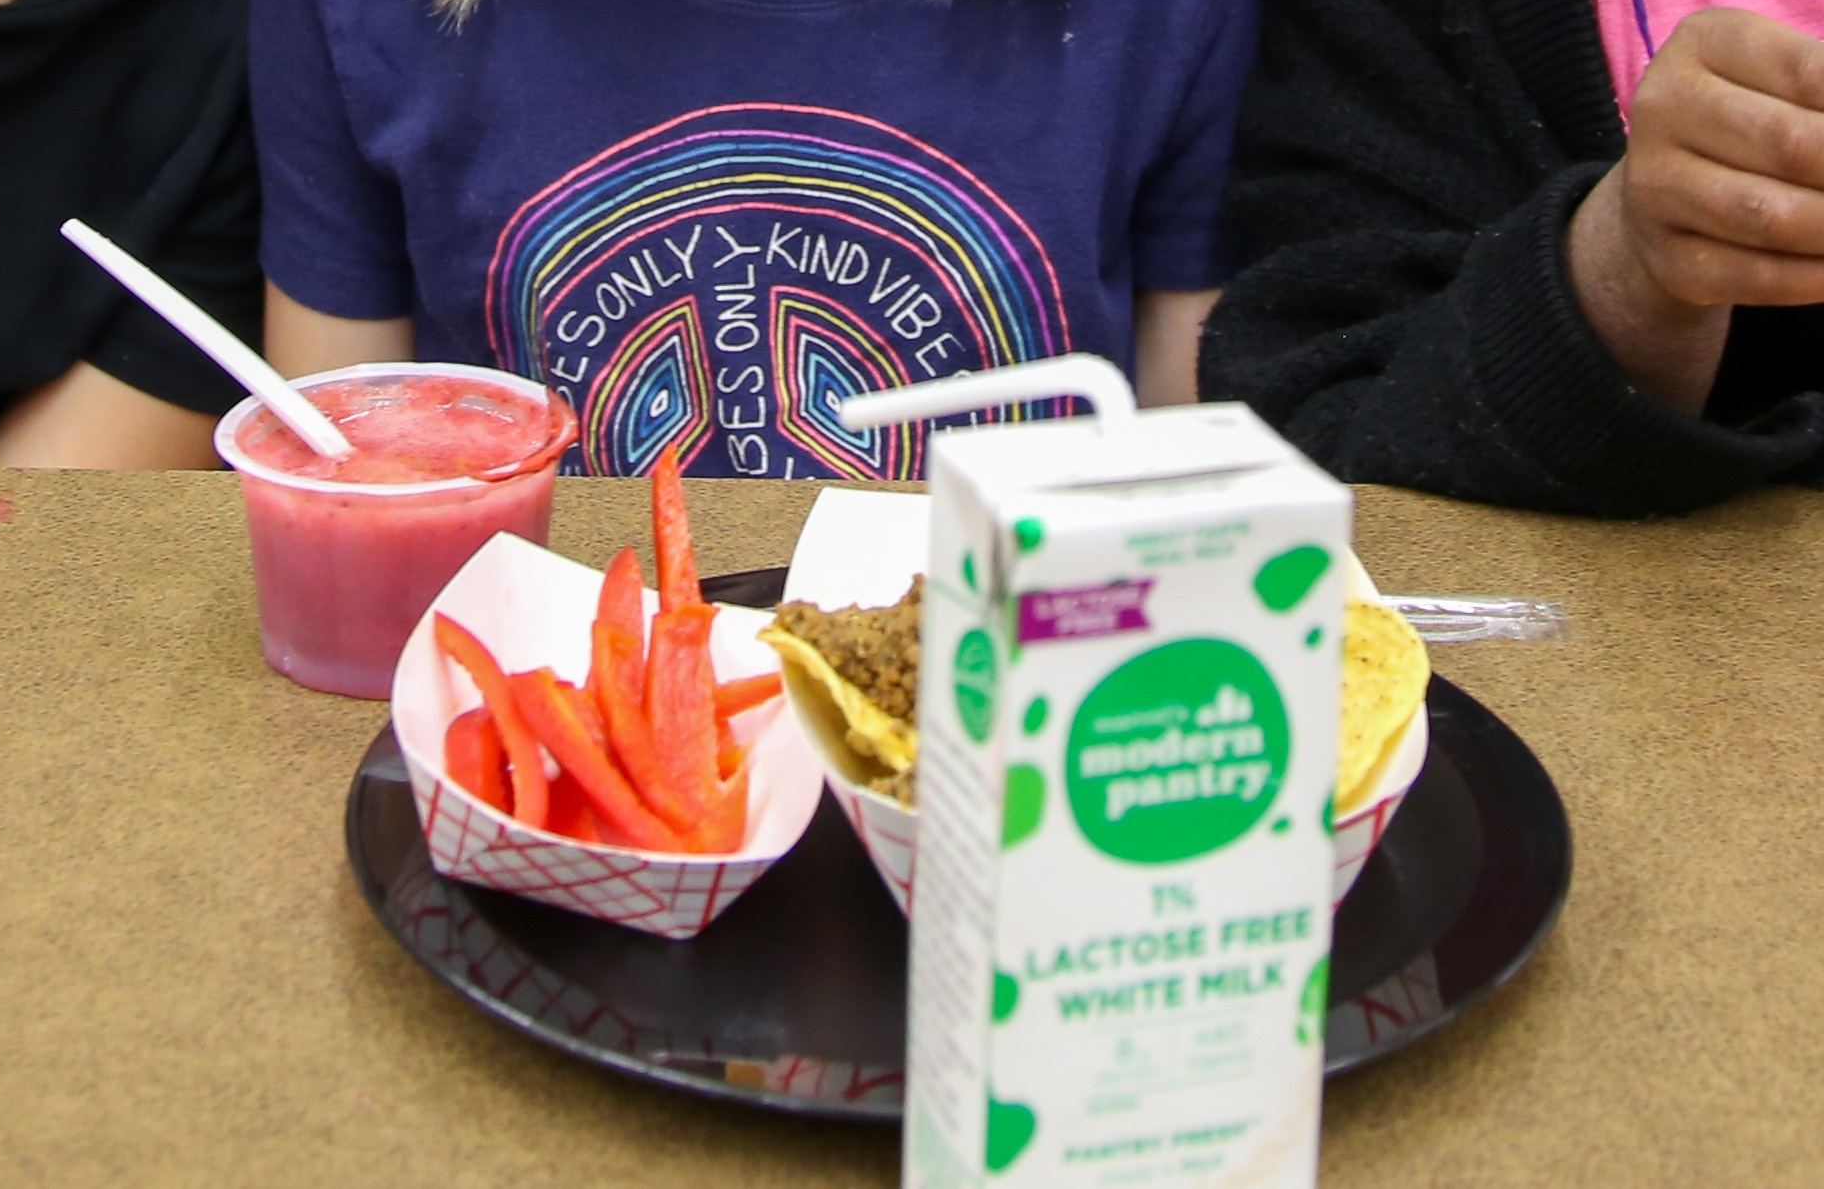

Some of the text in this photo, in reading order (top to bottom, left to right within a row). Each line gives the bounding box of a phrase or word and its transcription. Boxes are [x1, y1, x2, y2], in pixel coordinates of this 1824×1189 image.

[596, 224, 702, 321] ONLY
[764, 222, 870, 285] KIND
[867, 257, 971, 379] VIBE
[714, 224, 769, 477] BES ONLY
[1079, 724, 1266, 780] modern
[1104, 760, 1273, 822] pantry
[1151, 882, 1198, 916] 1%
[1025, 906, 1314, 982] LACTOSE FREE
[1057, 961, 1286, 1022] WHITE MILK
